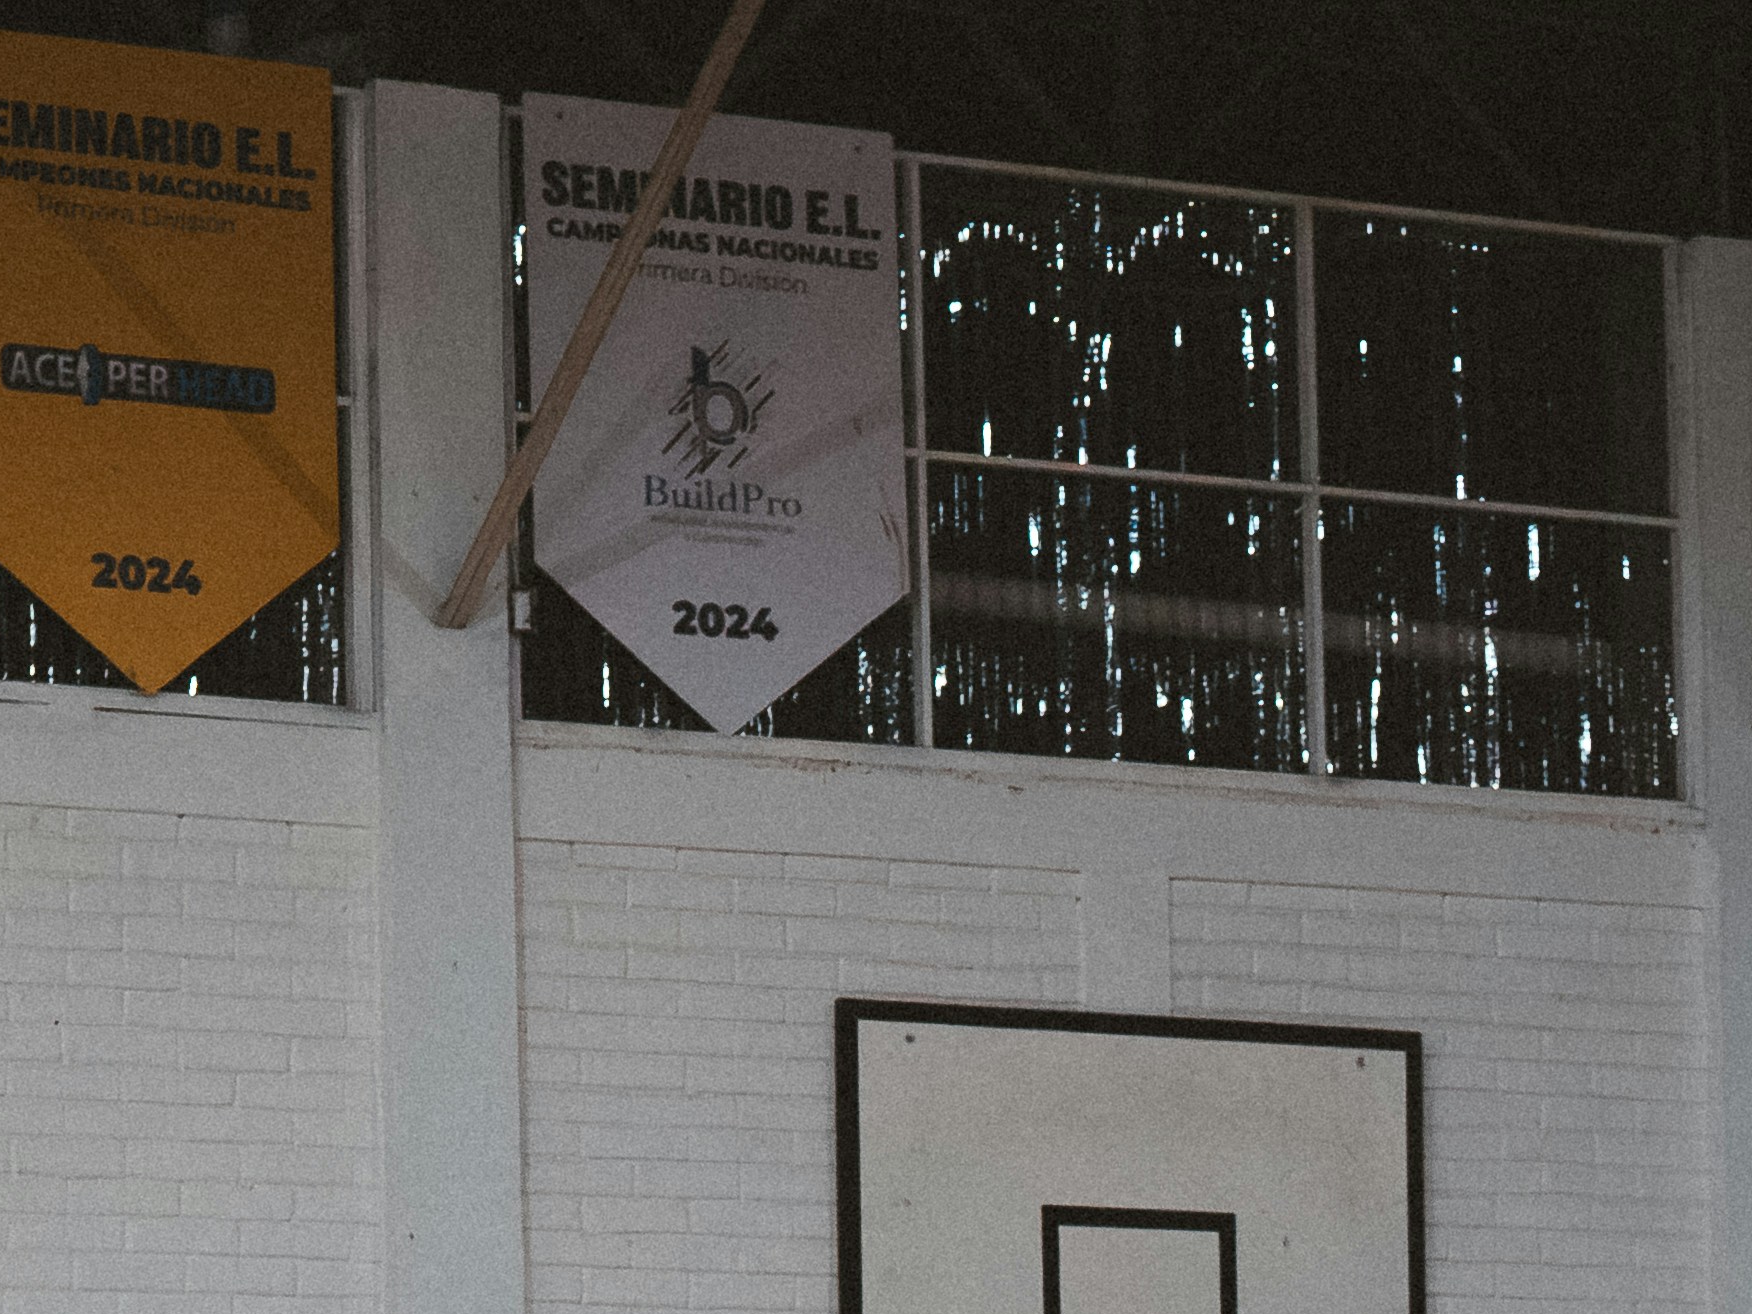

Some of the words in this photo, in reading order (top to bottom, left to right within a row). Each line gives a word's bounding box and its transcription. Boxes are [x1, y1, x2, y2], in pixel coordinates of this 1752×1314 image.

[235, 127, 317, 181] E.L.
[137, 171, 312, 212] NACIONALES
[805, 190, 882, 240] E.L.
[716, 234, 879, 271] NACIONALES
[8, 350, 76, 388] ACE
[108, 360, 169, 397] PER
[177, 366, 271, 407] HEAD
[644, 474, 803, 518] BuildPro
[91, 553, 202, 596] 2024
[671, 600, 779, 642] 2024
